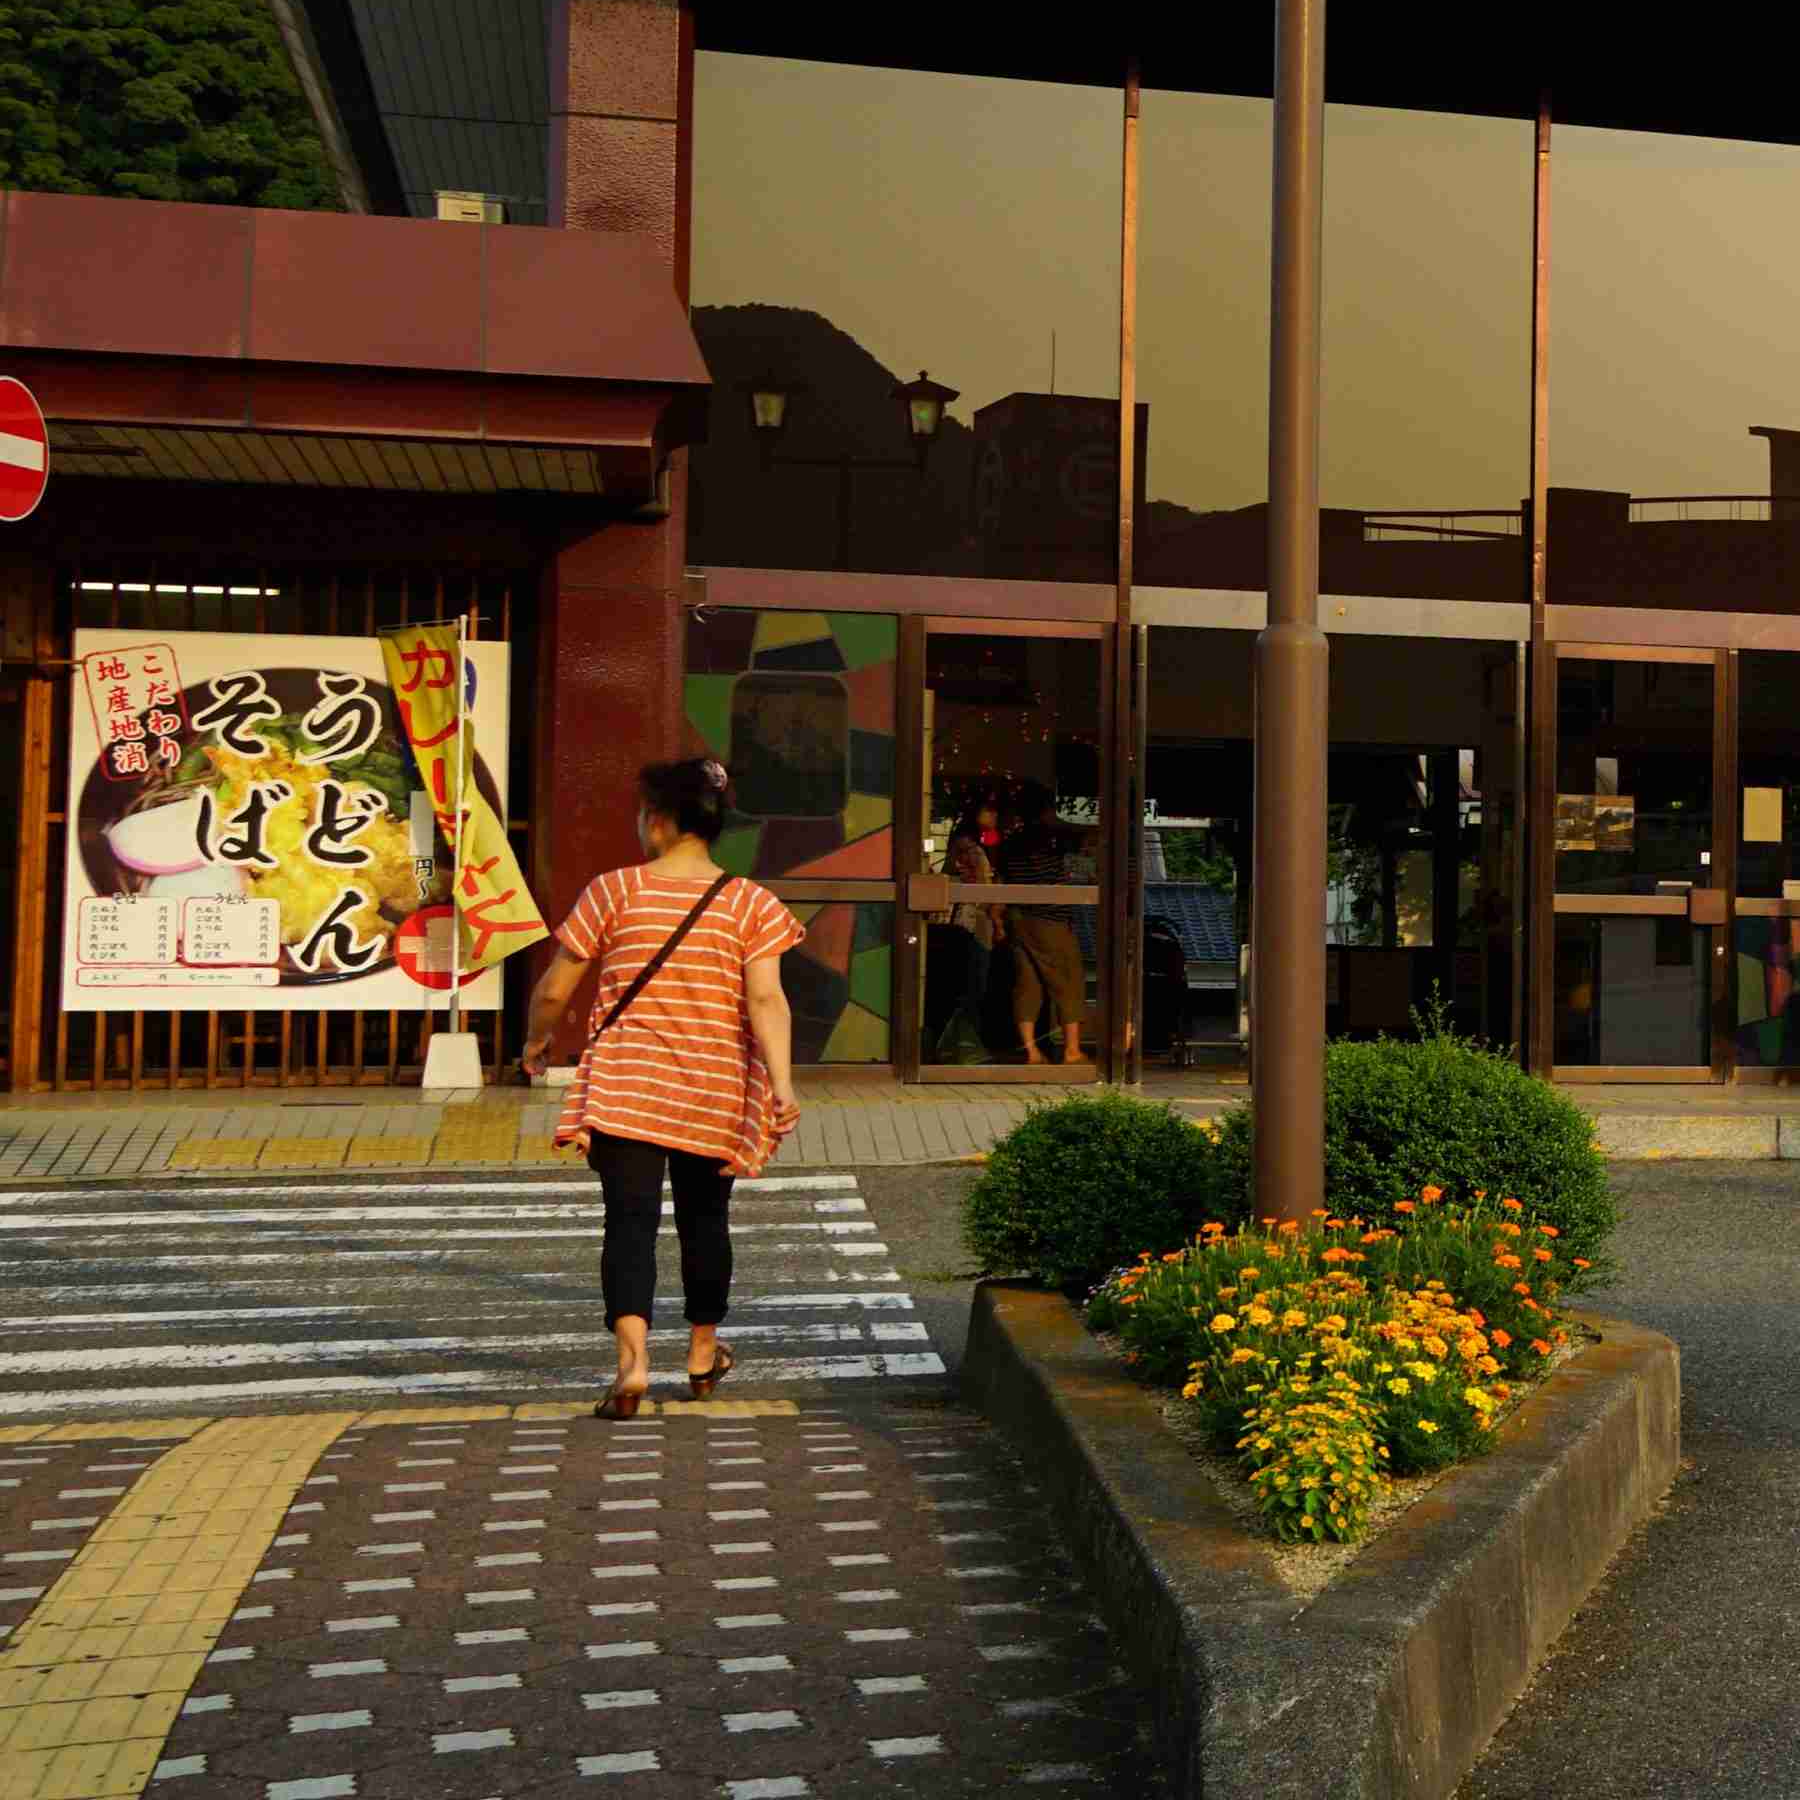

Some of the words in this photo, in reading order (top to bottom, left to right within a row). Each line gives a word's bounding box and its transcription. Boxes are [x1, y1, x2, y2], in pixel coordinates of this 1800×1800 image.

[98, 656, 148, 773] 地産地消
[142, 653, 181, 767] こだわり
[195, 673, 290, 865] そば
[300, 673, 387, 969] うどん
